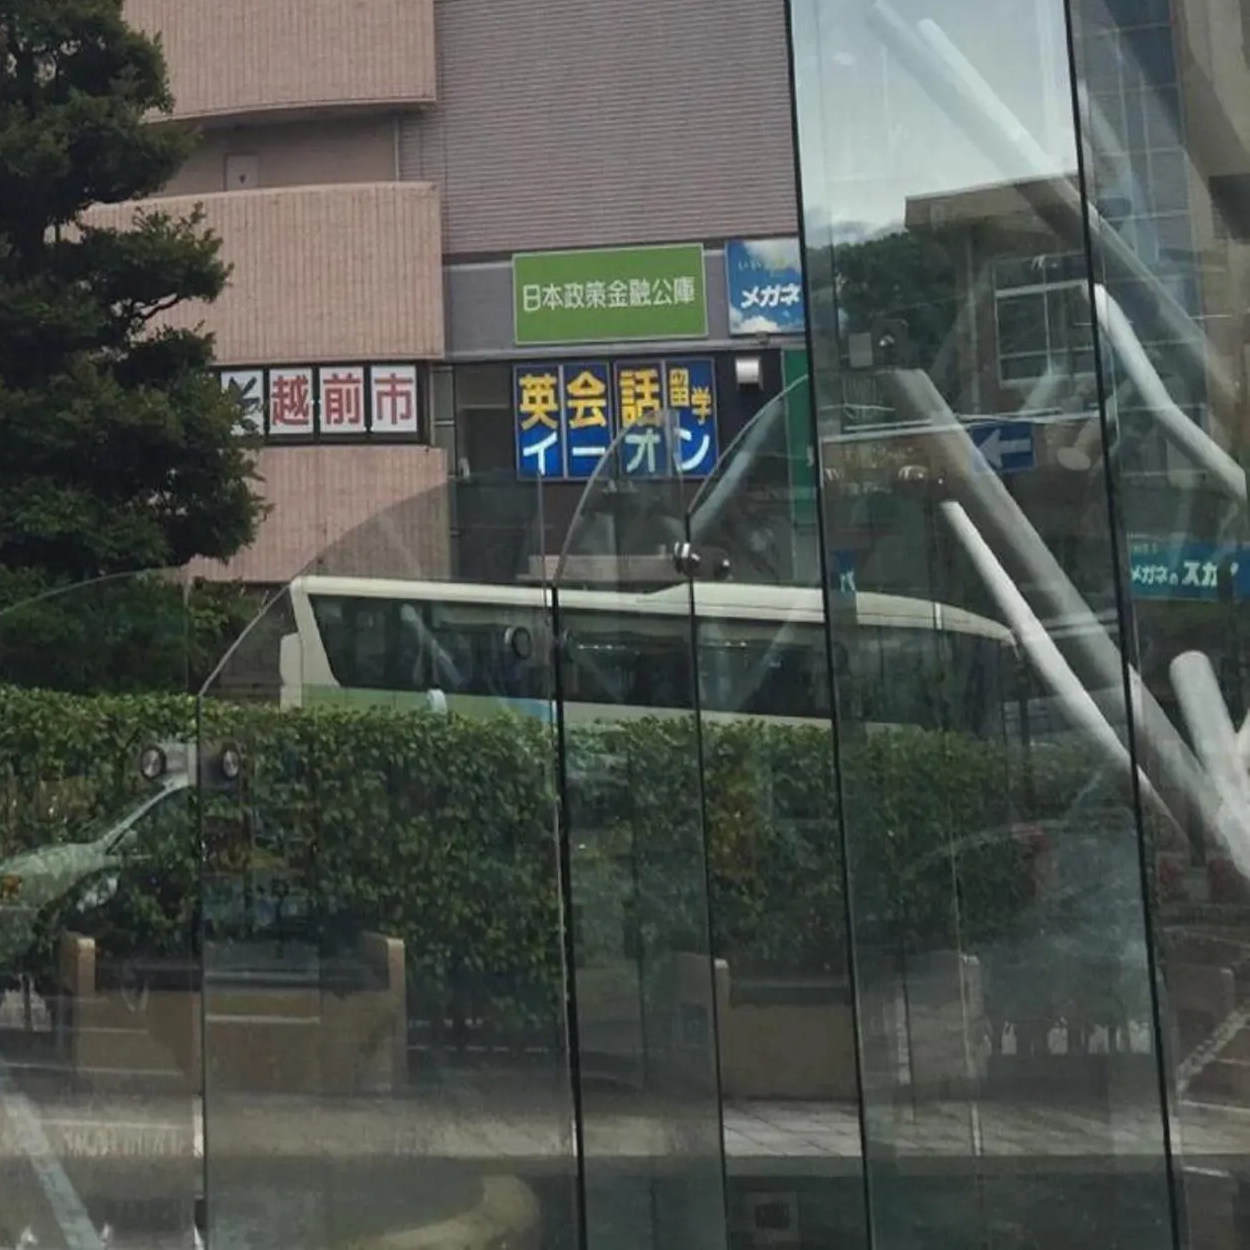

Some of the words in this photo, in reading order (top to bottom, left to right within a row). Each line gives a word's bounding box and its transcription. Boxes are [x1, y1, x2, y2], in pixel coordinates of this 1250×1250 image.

[523, 276, 695, 312] 日本政策金融公庫
[740, 283, 800, 308] メガネ
[520, 369, 659, 429] 英会話
[523, 429, 710, 476] イーオン
